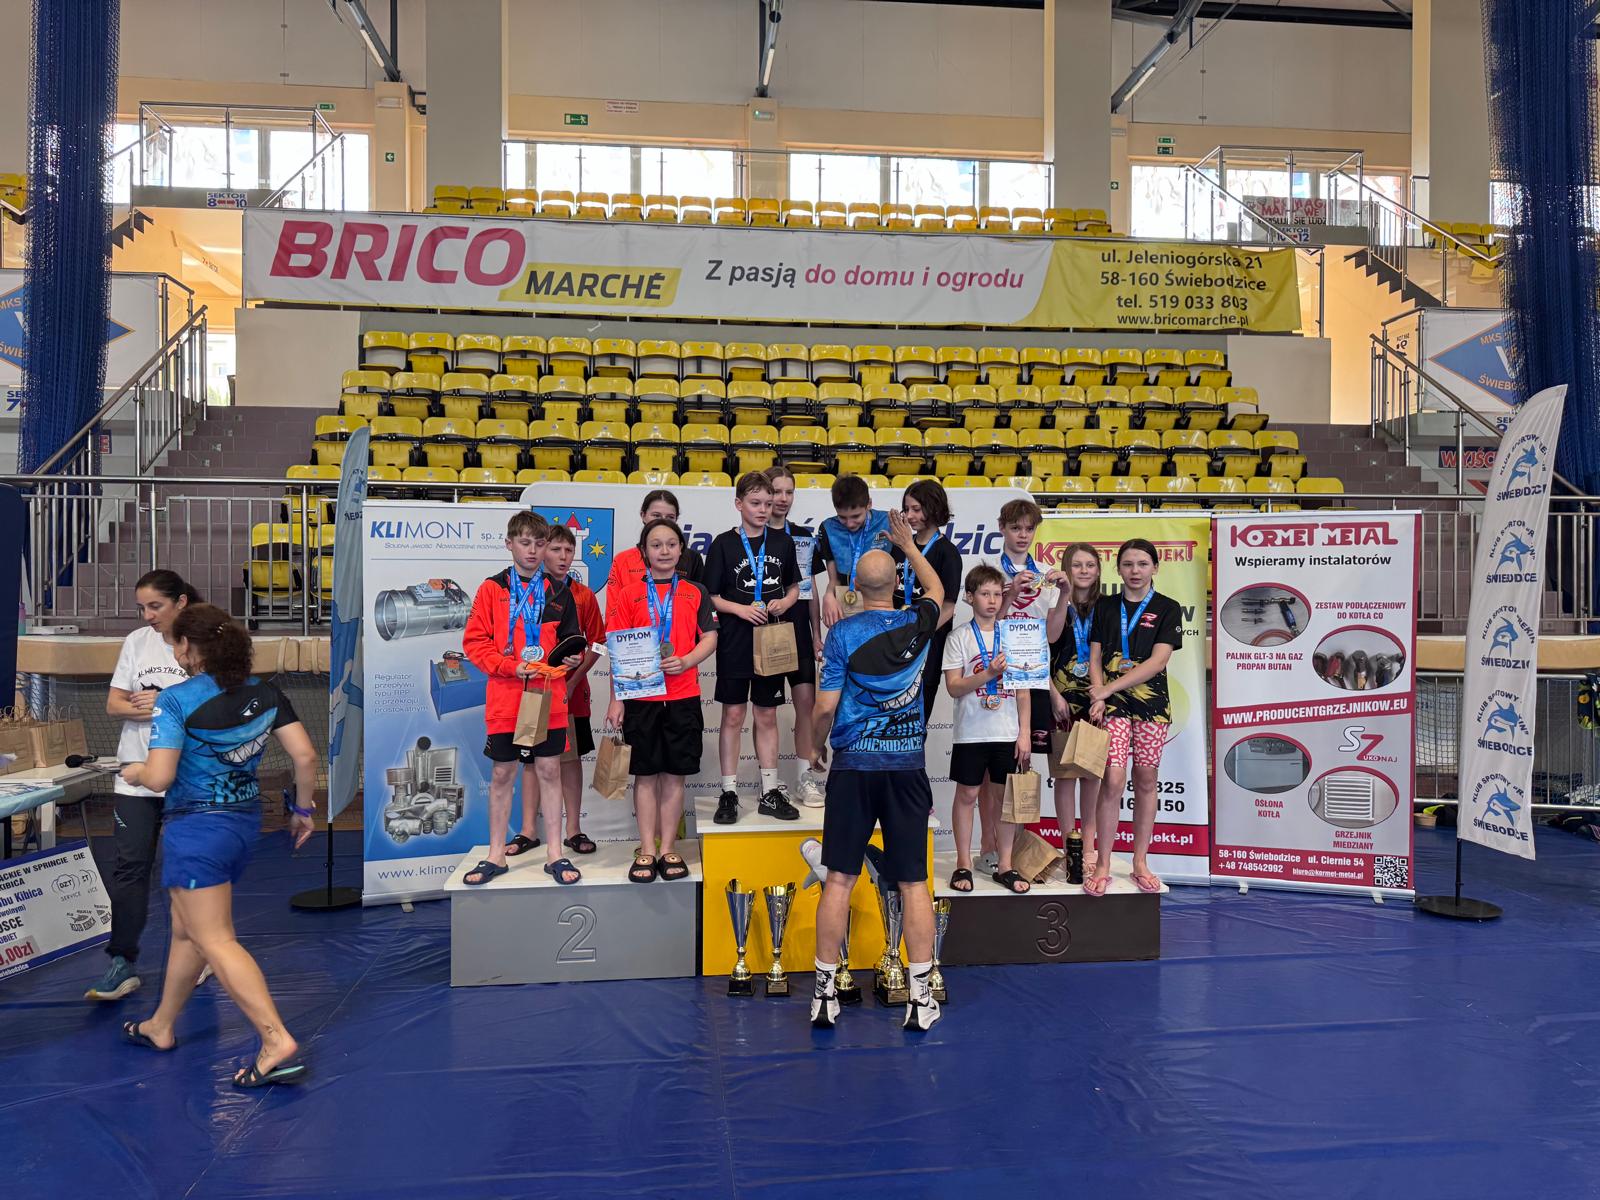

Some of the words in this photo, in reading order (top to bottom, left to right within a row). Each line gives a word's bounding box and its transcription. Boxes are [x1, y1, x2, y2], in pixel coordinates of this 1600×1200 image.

[270, 220, 526, 286] BRICO
[525, 270, 665, 300] MARCHÉ
[705, 260, 723, 280] Z
[728, 261, 797, 289] pasją
[805, 264, 836, 285] do
[844, 265, 914, 286] domu
[922, 267, 930, 286] i
[936, 268, 1024, 292] ogrodu
[1101, 249, 1121, 264] ul.
[1126, 250, 1241, 268] Jeleniogórska
[1245, 256, 1263, 269] 21
[1100, 272, 1159, 287] 58-160
[1165, 270, 1266, 291] Świebodzice
[1116, 294, 1142, 308] tel.
[1149, 295, 1179, 309] 519
[1185, 295, 1214, 309] 033
[1221, 295, 1248, 311] 803
[1117, 313, 1249, 327] www.bricomarche.pl
[370, 521, 475, 540] KLIMONT
[481, 531, 496, 541] sp.
[1231, 523, 1319, 547] KORMET
[1321, 522, 1398, 546] METAL
[1235, 555, 1305, 568] Wspieramy
[1309, 554, 1391, 566] instalatorów
[1315, 602, 1344, 610] ZESTAW
[1345, 601, 1406, 611] PODŁĄCZENIOWY
[1337, 612, 1347, 620] DO
[1349, 611, 1371, 620] KOTŁA
[1373, 612, 1383, 620] CO
[1009, 623, 1041, 632] DYPLOM
[616, 630, 651, 643] DYPLOM
[1226, 652, 1252, 660] PALNIK
[1254, 652, 1274, 660] GLT-3
[1276, 652, 1287, 660] NA
[1288, 652, 1303, 660] GAZ
[1236, 662, 1266, 671] PROPAN
[1268, 662, 1292, 671] BUTAN
[1223, 698, 1408, 725] WWW.PRODUCENTGRZEJNIKOW.EU
[1477, 701, 1488, 722] KLUB
[1472, 782, 1483, 803] KLUB
[1254, 798, 1284, 808] OSŁONA
[1258, 809, 1281, 819] KOTŁA
[1335, 830, 1372, 840] GRZEJNIK
[1332, 840, 1374, 850] MIEDZIANY
[23, 866, 31, 875] W
[32, 856, 69, 873] SPRINCIE
[1218, 850, 1247, 859] 58-160
[1249, 850, 1301, 863] Świebodzice
[1308, 855, 1319, 864] ul.
[1321, 856, 1351, 866] Ciernie
[1353, 857, 1365, 867] 54
[1218, 862, 1236, 871] +48
[14, 886, 44, 903] Kibica
[60, 890, 82, 902] SERVICE
[556, 903, 598, 964] 2
[1035, 901, 1071, 957] 3
